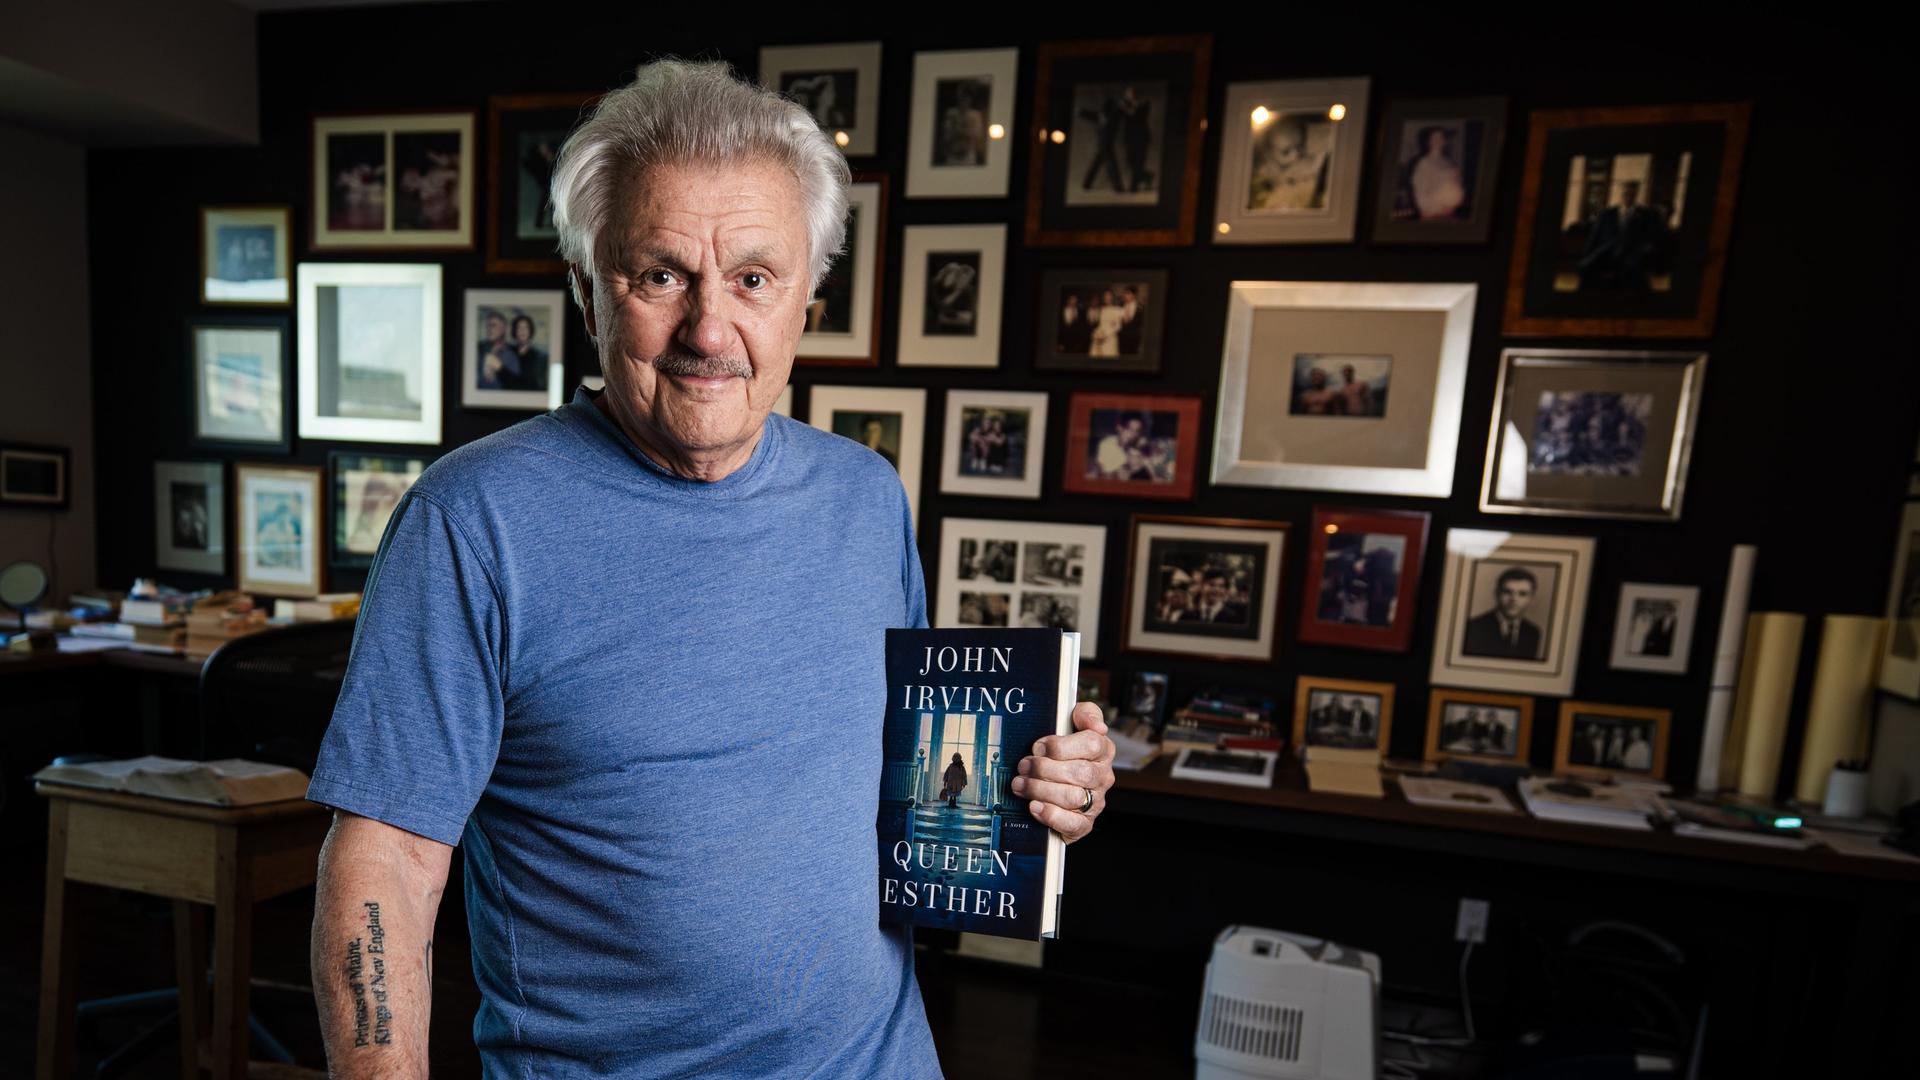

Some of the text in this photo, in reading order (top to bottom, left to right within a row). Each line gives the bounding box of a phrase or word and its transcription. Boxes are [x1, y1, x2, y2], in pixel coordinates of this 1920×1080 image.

[919, 646, 1013, 675] JOHN
[902, 685, 1026, 714] IRVING
[893, 840, 1012, 876] QUEEN
[883, 878, 1018, 920] ESTHER
[365, 902, 392, 1045] Kings of New England
[355, 999, 369, 1048] Princes
